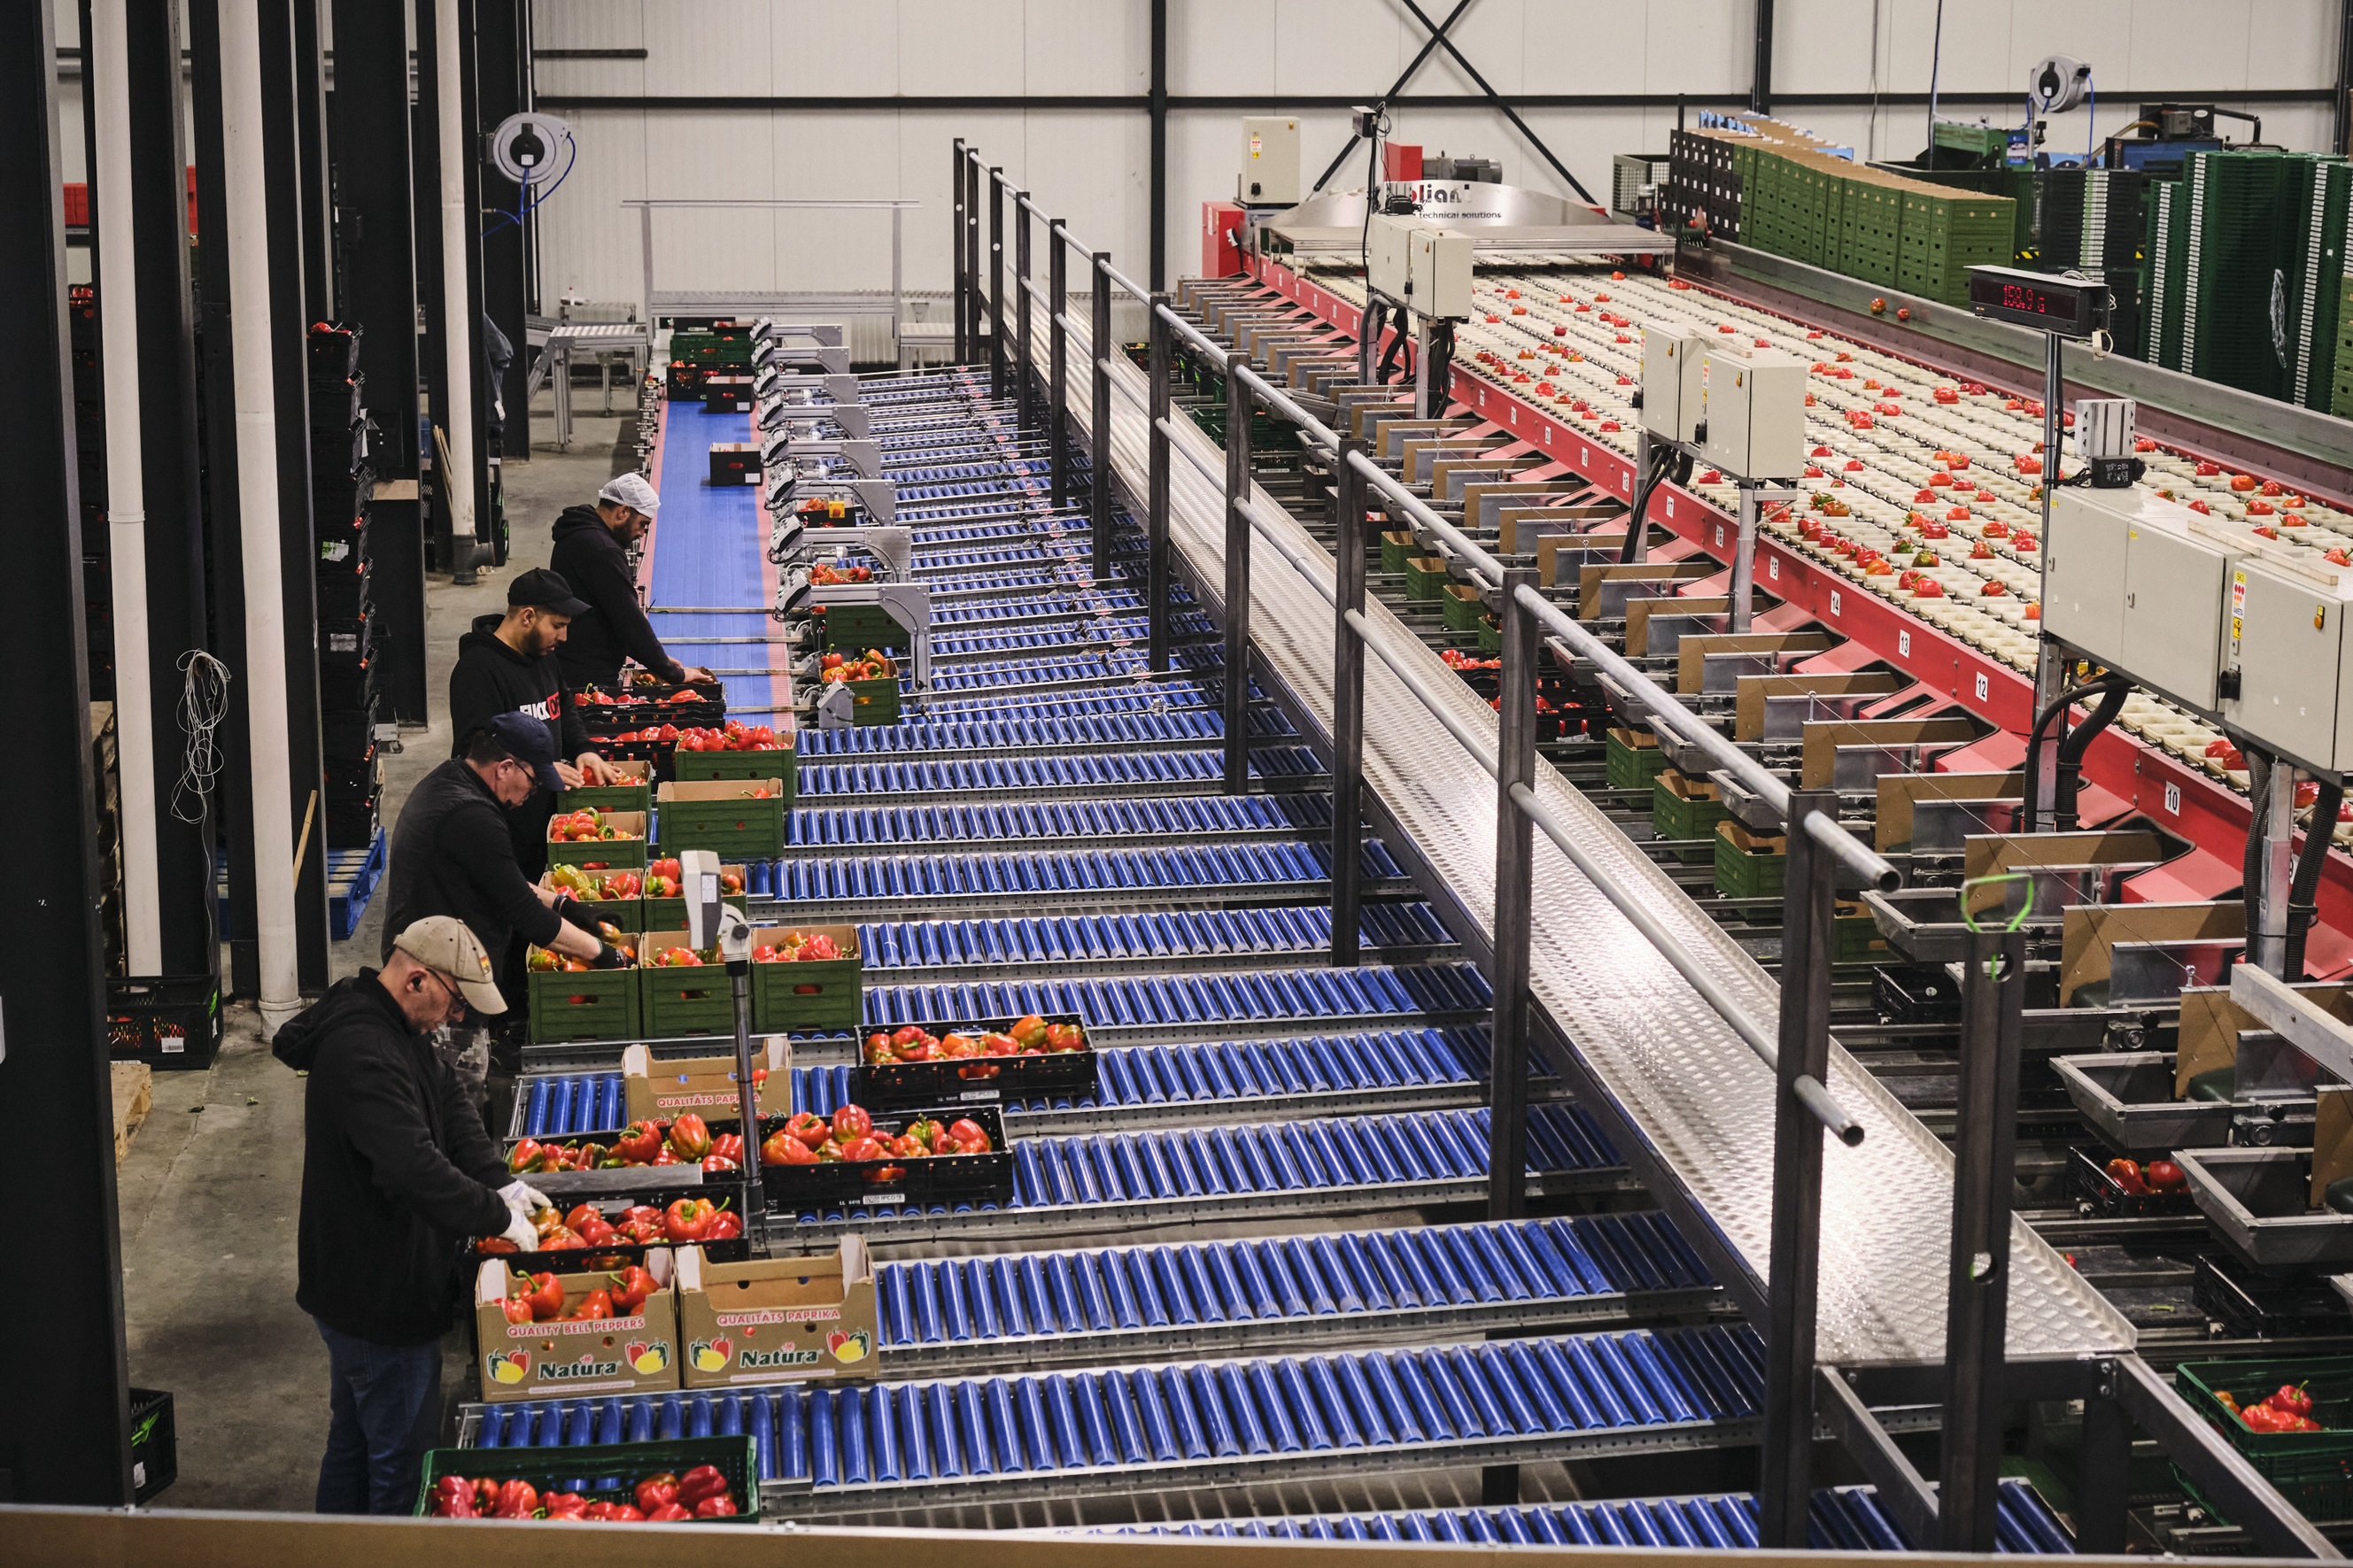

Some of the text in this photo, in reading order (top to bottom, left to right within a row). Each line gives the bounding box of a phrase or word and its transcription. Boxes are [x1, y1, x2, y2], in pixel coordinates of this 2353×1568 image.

[1419, 210, 1502, 220] technical solutions
[1668, 499, 1674, 515] 17
[1716, 529, 1723, 545] 16
[1771, 560, 1777, 576] 15
[1832, 595, 1839, 612] 14
[1900, 634, 1908, 653] 13
[1978, 678, 1986, 698] 12
[2167, 788, 2178, 811] 10
[657, 1093, 761, 1107] QUALITÄTS PAPA
[717, 1309, 840, 1326] QUALITÄTS PAPRIKA
[507, 1317, 645, 1338] QUALITY BELL PEPPERS
[739, 1348, 818, 1368] Natura
[538, 1360, 617, 1380] Natura
